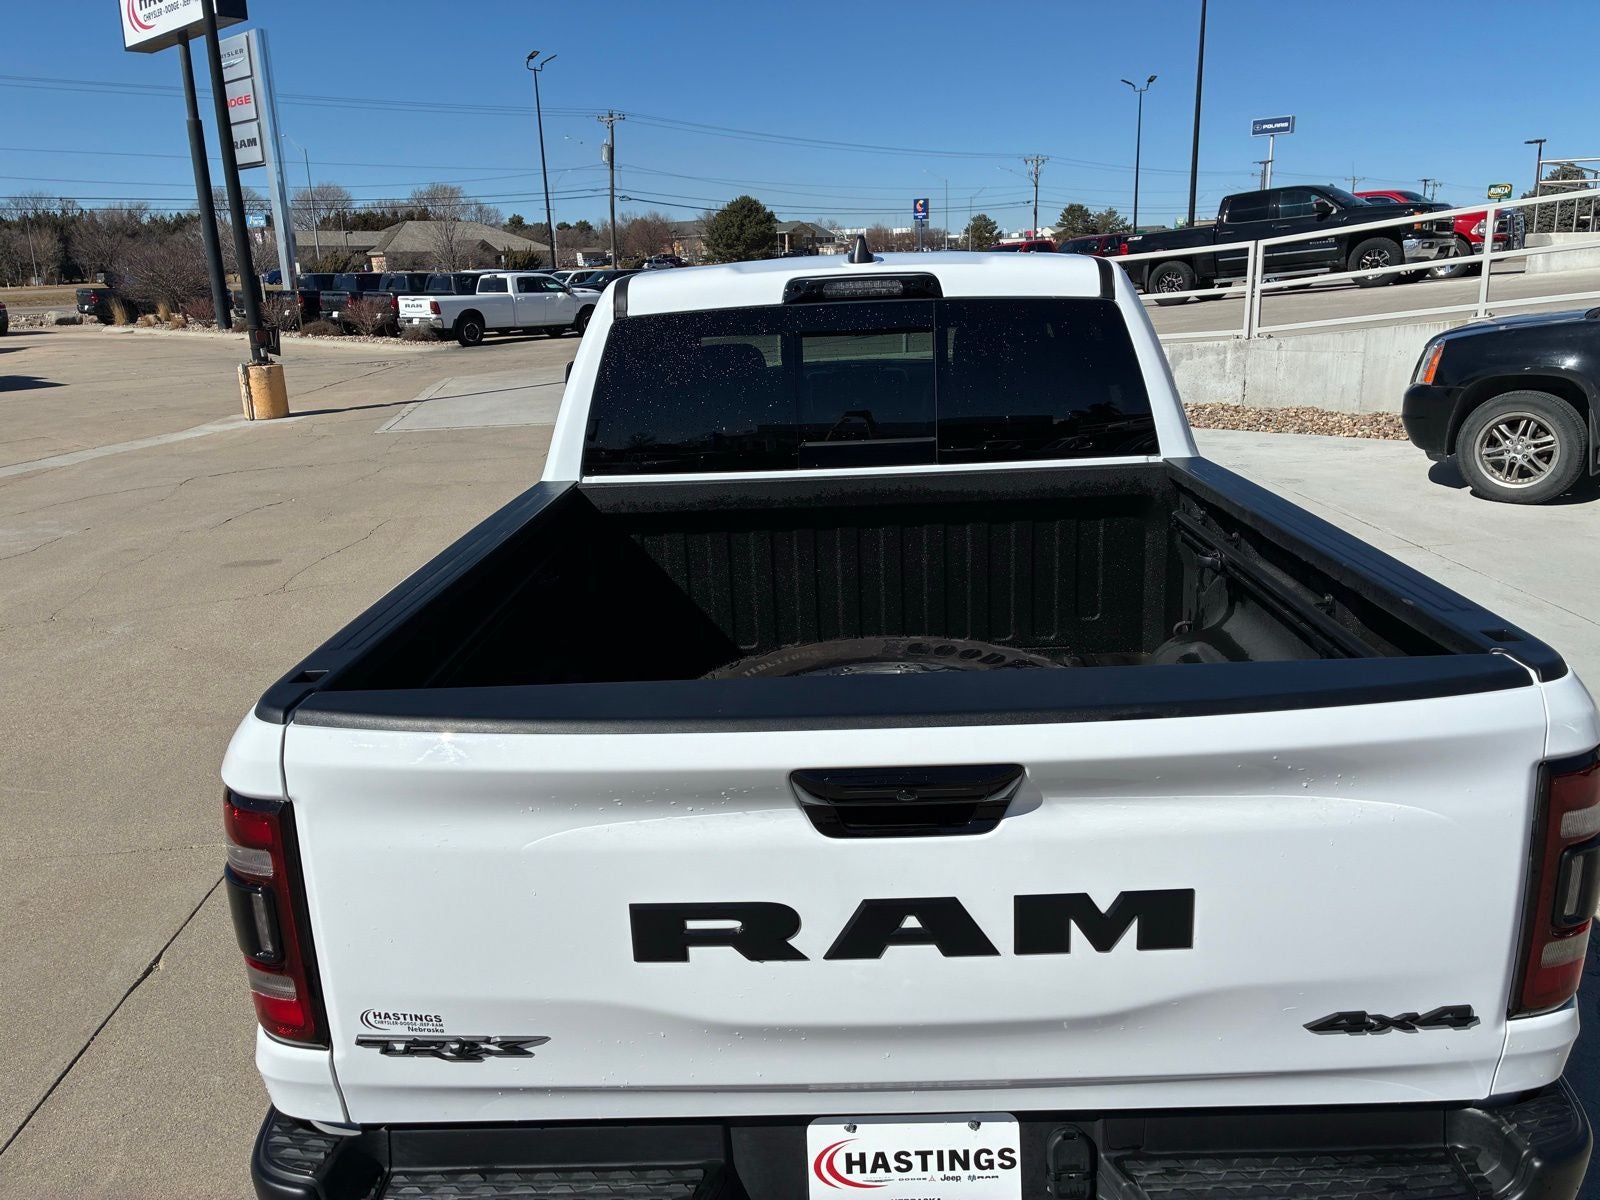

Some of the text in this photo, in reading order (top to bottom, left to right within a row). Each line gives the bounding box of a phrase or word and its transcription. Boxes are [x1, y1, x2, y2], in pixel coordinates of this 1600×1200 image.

[143, 8, 162, 22] CHRYSLER
[227, 95, 251, 108] DGE
[629, 888, 1195, 962] RAM
[373, 1011, 442, 1022] HASTINGS
[845, 1147, 1018, 1174] HASTINGS
[940, 1174, 962, 1182] Jeep
